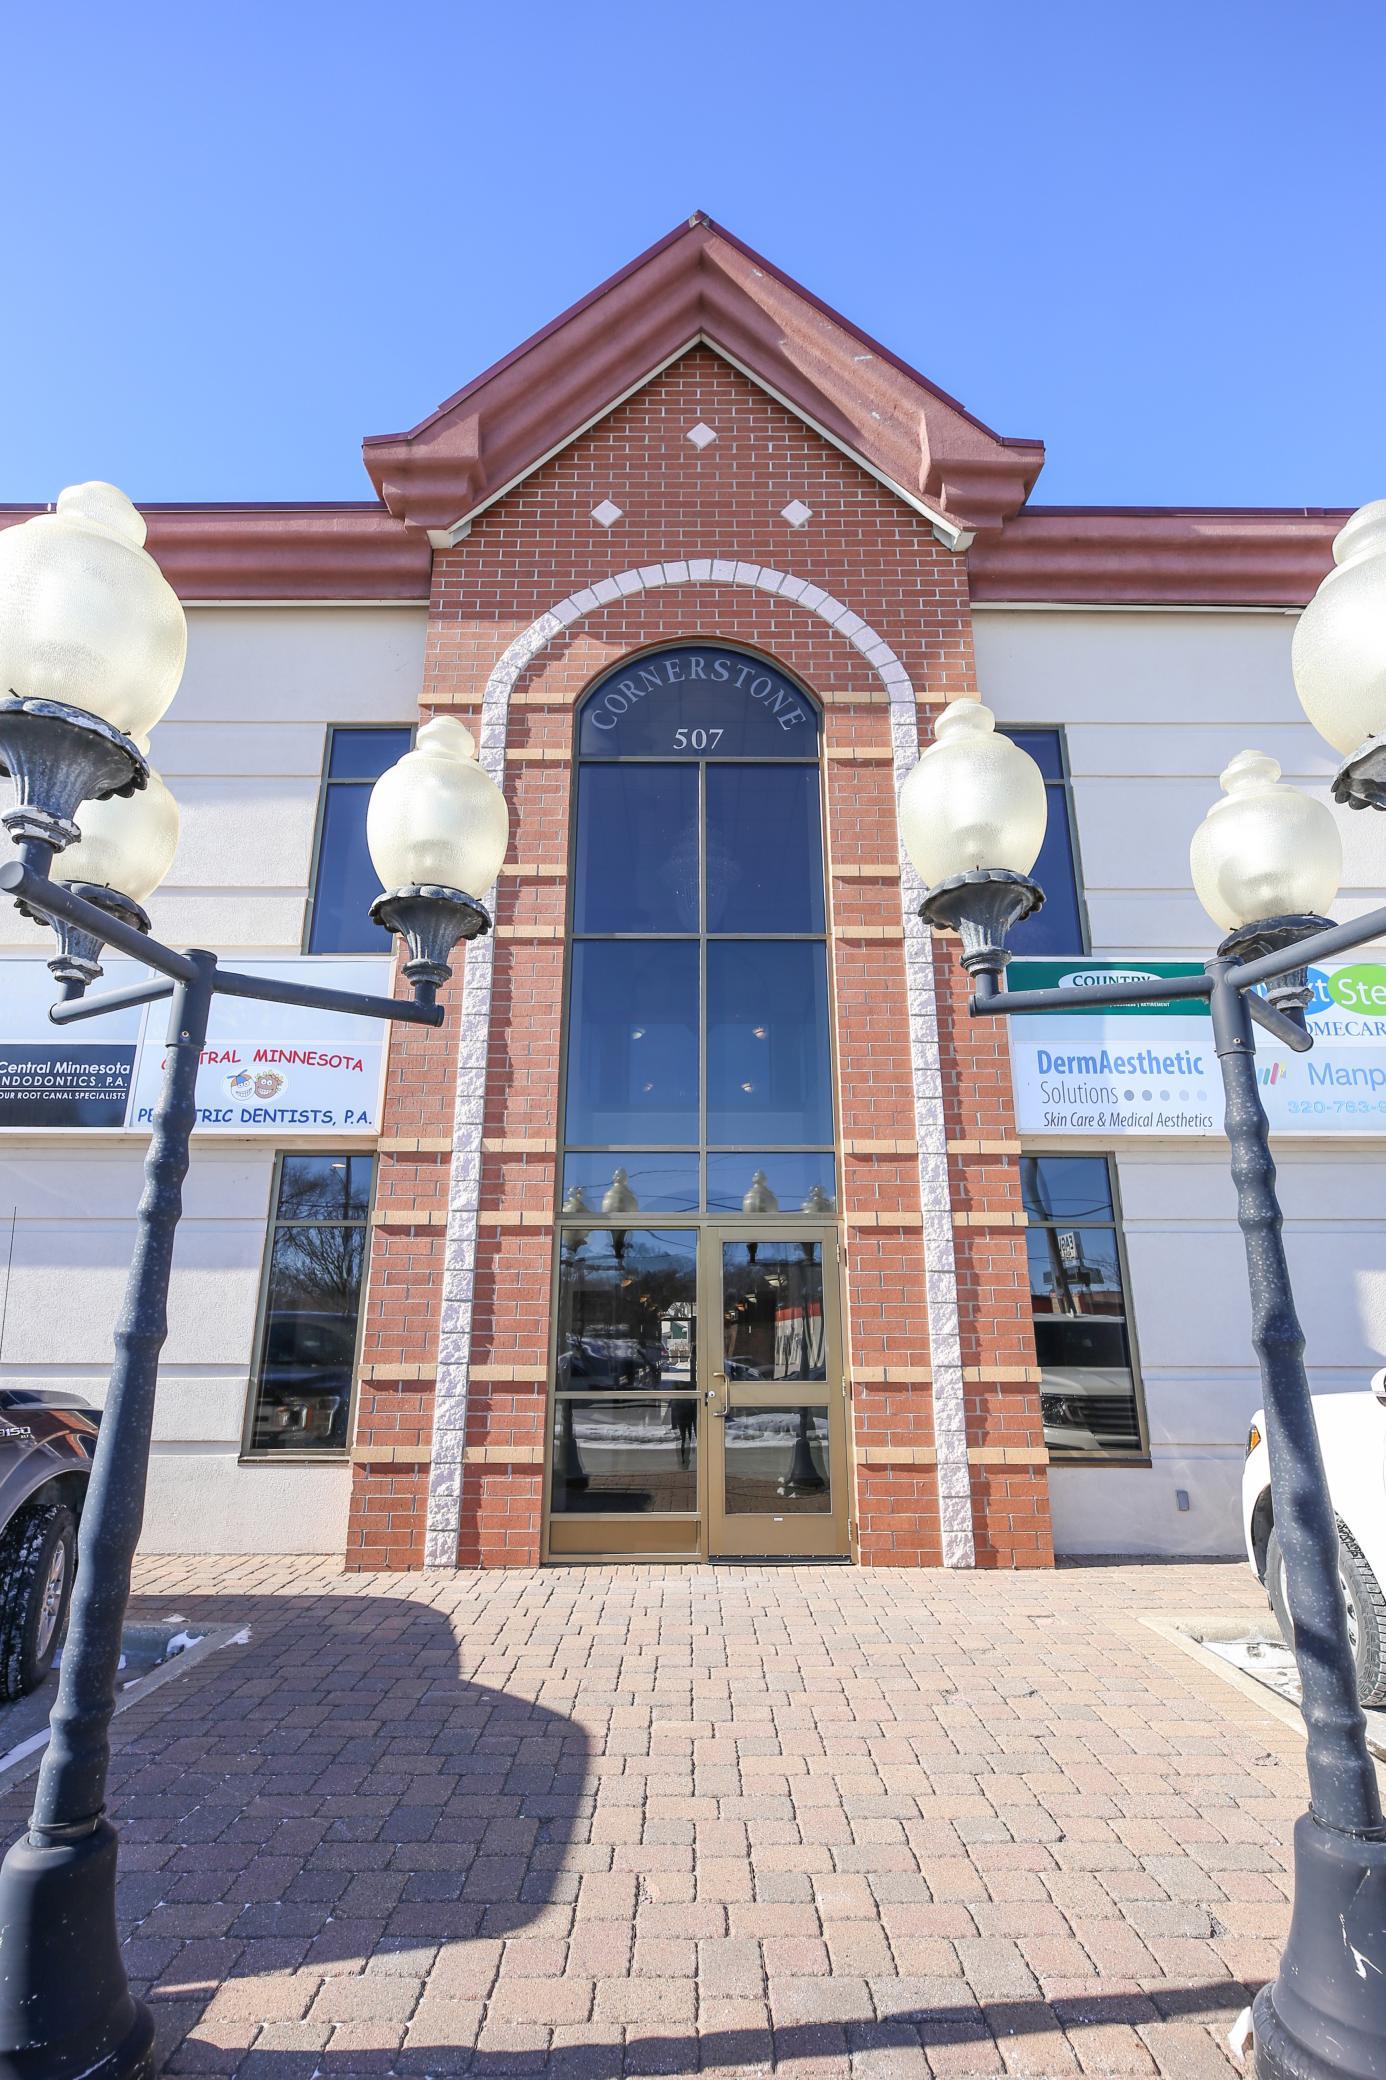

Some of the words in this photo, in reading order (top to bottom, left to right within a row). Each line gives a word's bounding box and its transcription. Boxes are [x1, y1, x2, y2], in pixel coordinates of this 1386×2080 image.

[591, 656, 807, 731] CORNERSTONE
[673, 728, 724, 750] 507
[0, 1061, 50, 1074] Central
[54, 1061, 130, 1075] Minnesota
[161, 1049, 241, 1070] TRAL
[253, 1048, 363, 1072] MINNESOTA
[1037, 1050, 1204, 1075] DermAesthetic
[106, 1076, 128, 1087] P.A.
[1307, 1062, 1386, 1092] Manp
[17, 1092, 40, 1100] ROOT
[43, 1092, 72, 1100] CANAL
[75, 1092, 126, 1100] SPECIALISTS
[1040, 1080, 1119, 1105] Solutions
[240, 1108, 336, 1126] DENTISTS,
[344, 1109, 372, 1125] P.A.
[1044, 1111, 1067, 1127] Skin
[1070, 1111, 1095, 1127] Care
[1097, 1112, 1107, 1127] &
[1109, 1111, 1154, 1127] Medical
[1156, 1112, 1213, 1128] Aesthetics
